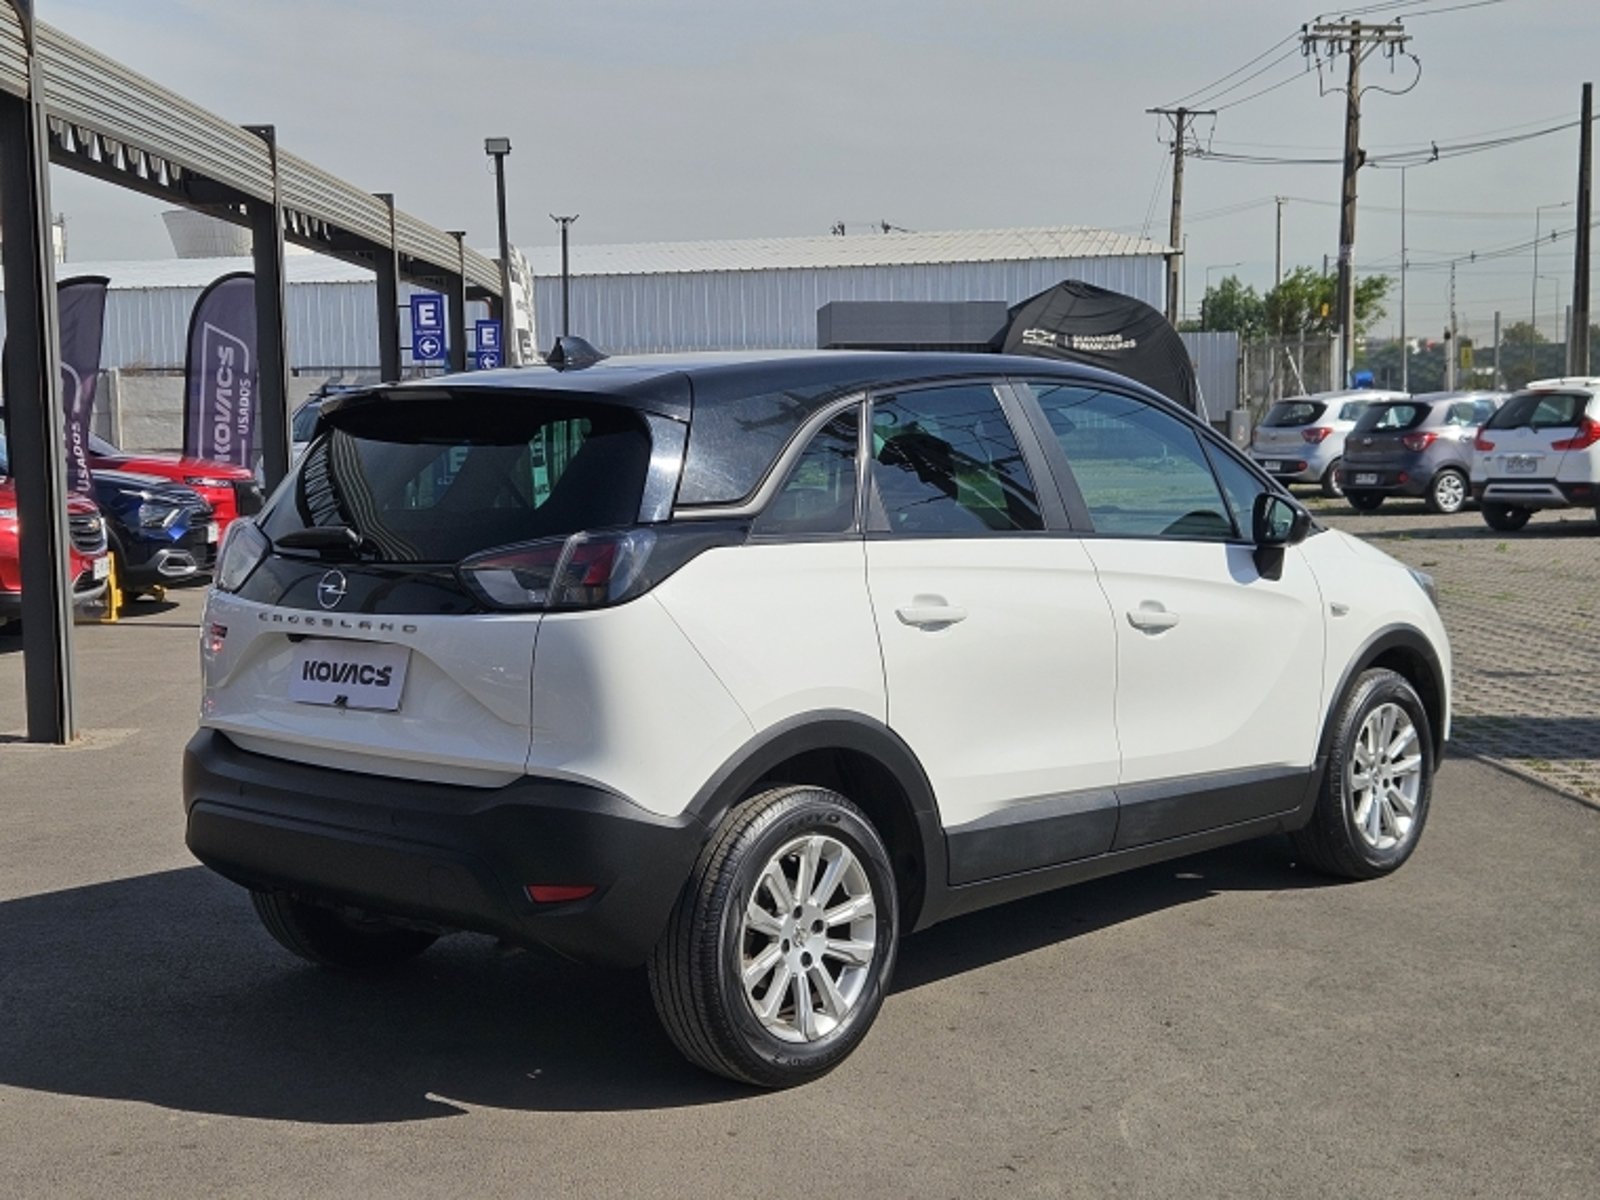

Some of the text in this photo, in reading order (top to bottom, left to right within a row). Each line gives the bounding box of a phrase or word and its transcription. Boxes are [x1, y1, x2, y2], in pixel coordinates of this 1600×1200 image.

[418, 303, 436, 326] E
[481, 327, 496, 346] E
[213, 345, 235, 462] KOVACS
[237, 378, 252, 435] USADOS
[70, 421, 92, 492] USADOS
[258, 611, 417, 634] CROSSLAND
[302, 660, 393, 687] KOVACS
